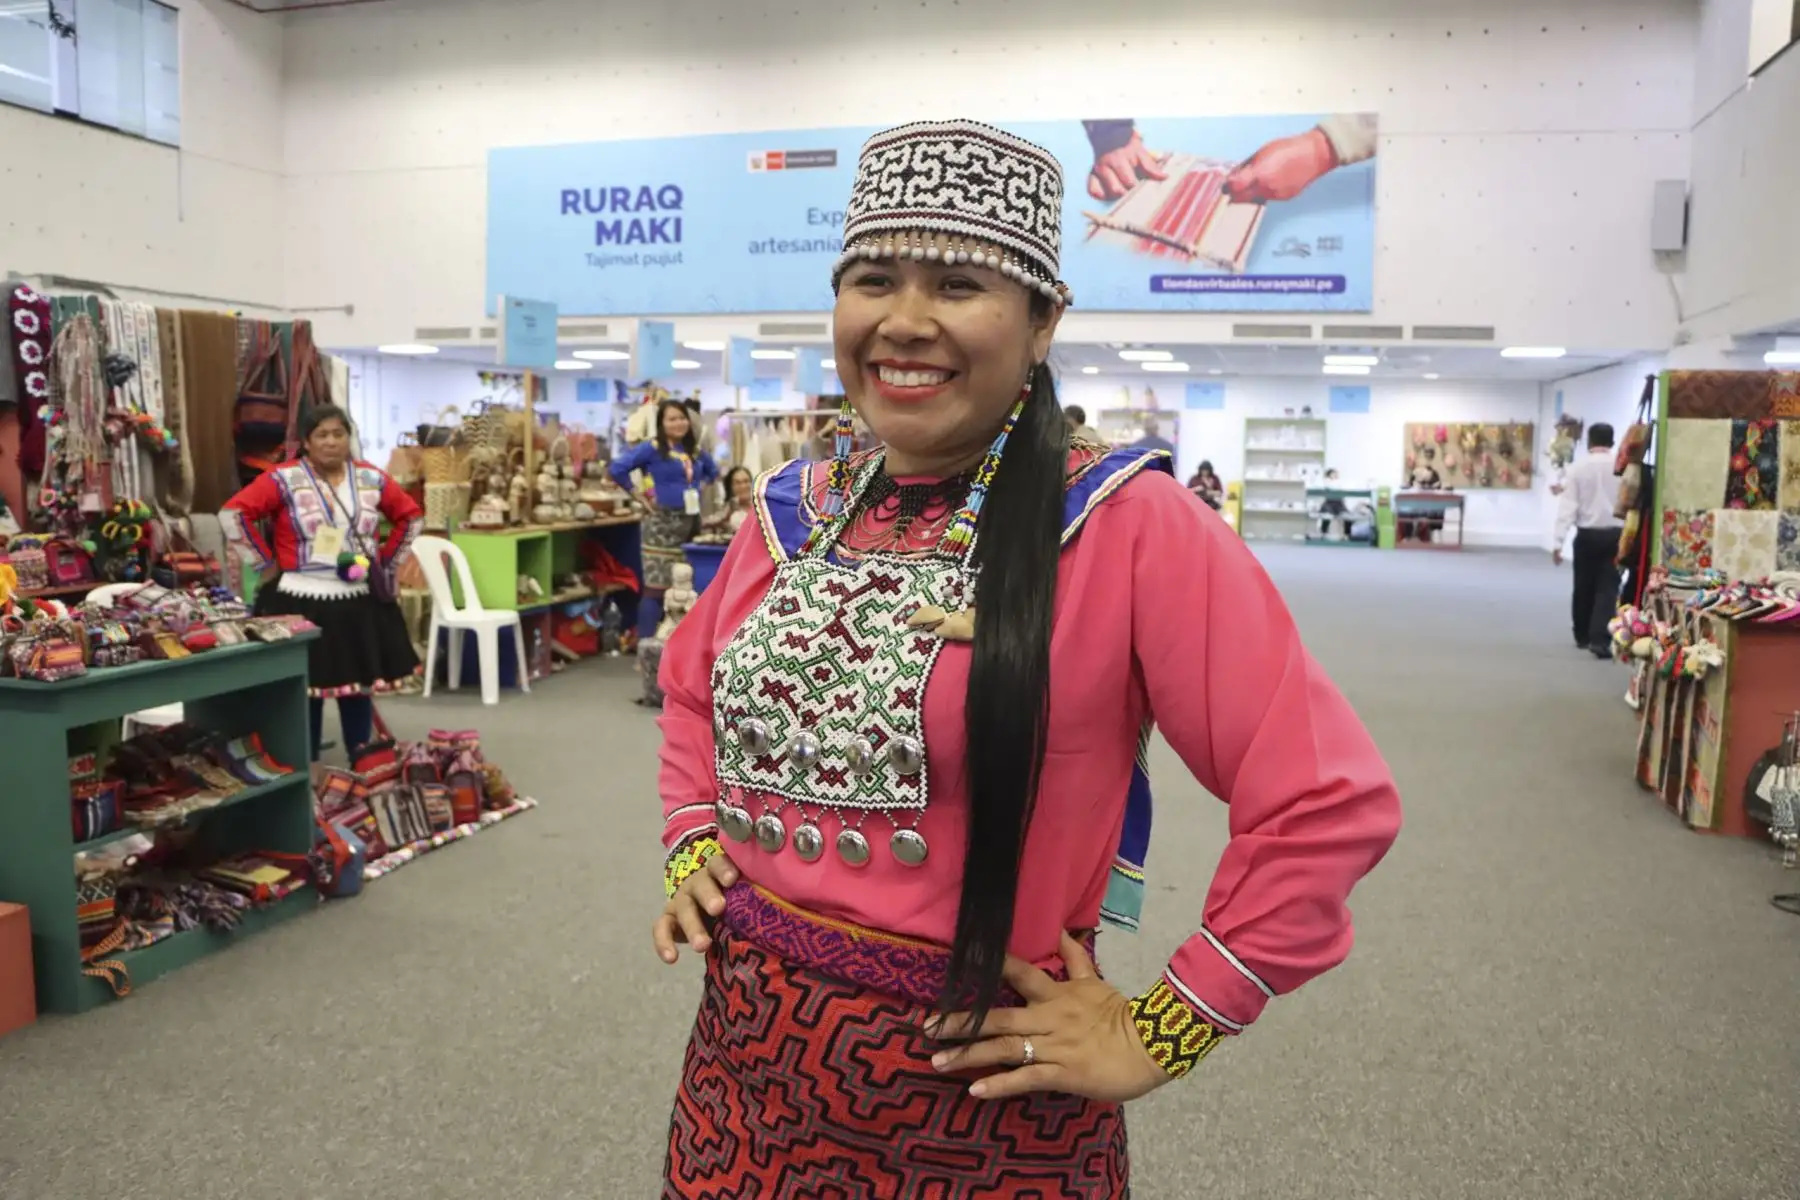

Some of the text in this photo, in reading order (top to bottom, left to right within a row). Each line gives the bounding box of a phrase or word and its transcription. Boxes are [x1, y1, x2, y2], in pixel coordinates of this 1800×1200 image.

[560, 184, 683, 215] RURAQ
[595, 216, 682, 246] MAKI
[806, 206, 846, 228] Exp
